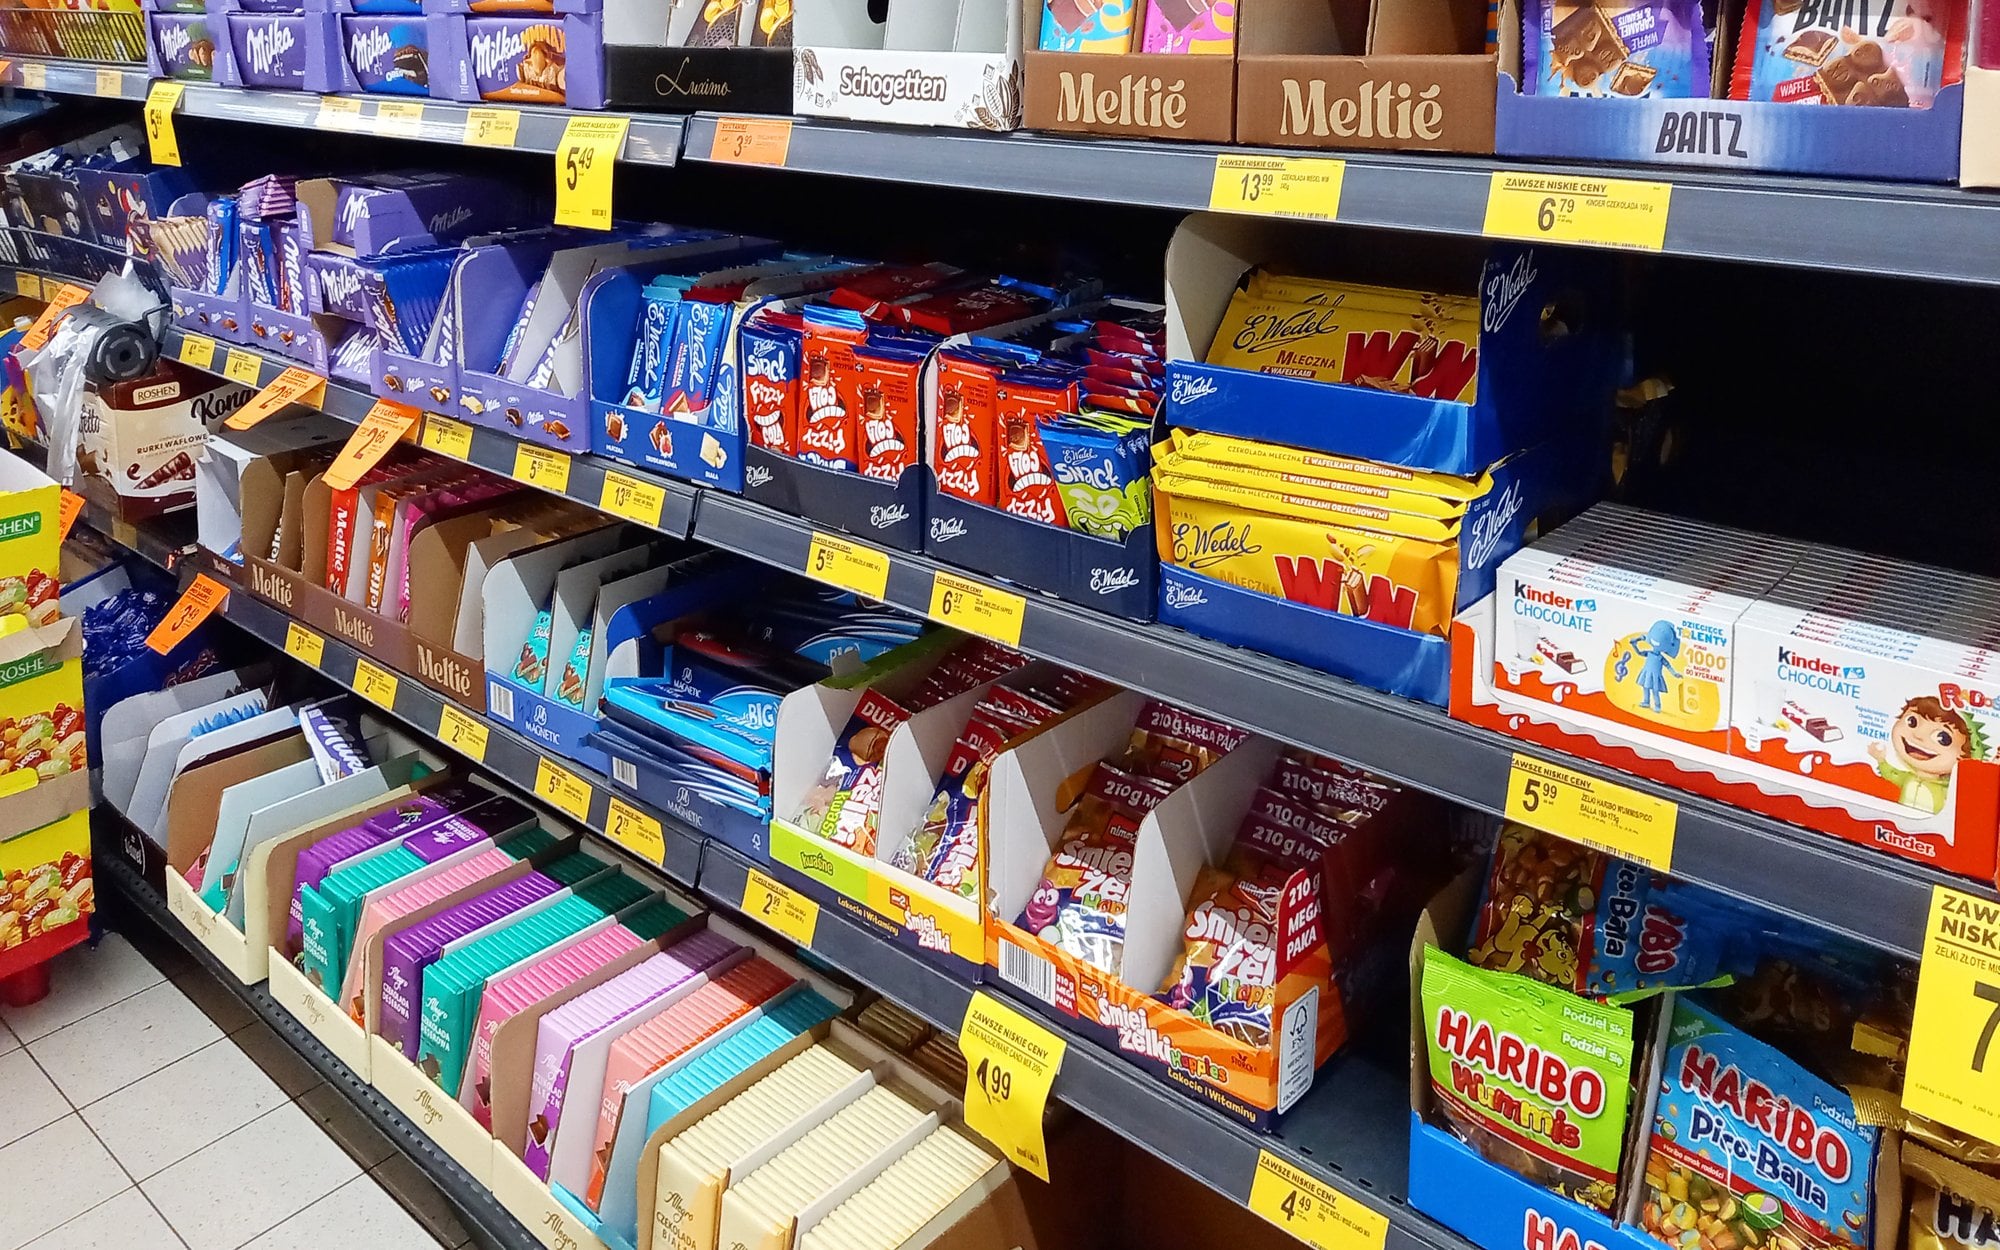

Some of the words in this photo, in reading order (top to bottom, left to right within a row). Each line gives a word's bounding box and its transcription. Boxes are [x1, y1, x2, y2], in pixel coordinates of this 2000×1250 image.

[160, 22, 191, 62] Milka
[1618, 15, 1655, 38] CARAMEL
[1631, 32, 1658, 50] WAFFLE
[246, 19, 294, 74] Milka
[351, 25, 392, 73] Milka
[471, 25, 525, 79] Milka
[655, 56, 732, 97] Luximo
[839, 65, 948, 107] Schogetten
[1780, 79, 1811, 97] WAFFLE
[1057, 71, 1188, 130] Meltié
[1280, 79, 1444, 141] Meltié
[1655, 112, 1748, 159] BAITZ
[566, 147, 579, 191] 5
[579, 148, 595, 170] 49
[1220, 159, 1245, 167] ZAWSZE
[1241, 173, 1261, 201] 13
[1262, 174, 1274, 186] 99
[1505, 178, 1545, 190] ZAWSZE
[1546, 181, 1578, 192] NISKIE
[1580, 183, 1608, 193] CENY
[1537, 198, 1556, 231] 6
[1560, 198, 1575, 213] 79
[320, 266, 361, 306] Milka
[747, 351, 787, 382] Snack
[137, 385, 177, 401] ROSHEN
[750, 380, 785, 405] Fizzy
[808, 386, 836, 411] COLA
[136, 441, 164, 454] RURKI
[163, 432, 209, 450] WAFLOWE
[802, 428, 846, 455] Fizzy
[865, 420, 895, 444] COLA
[943, 424, 970, 449] COLA
[1008, 451, 1040, 479] COLA
[1227, 445, 1267, 458] CZEKOLADA
[1268, 452, 1302, 463] MLECZNA
[1311, 457, 1354, 472] WAFELKAMI
[1355, 464, 1412, 481] ORZECHOWYMI
[1289, 475, 1331, 490] WAFELKAMI
[1331, 481, 1389, 499] ORZECHOWYMI
[1248, 490, 1281, 502] MLECZNA
[1290, 496, 1331, 511] WAFELKAMI
[1331, 502, 1389, 521] ORZECHOWYMI
[334, 506, 348, 572] Meltié
[816, 548, 826, 571] 5
[252, 563, 293, 609] Meltié
[942, 590, 953, 615] 6
[1514, 598, 1593, 634] CHOCOLATE
[334, 606, 375, 649] Meltié
[417, 643, 472, 698] Meltié
[1685, 648, 1727, 671] 1000
[1777, 664, 1862, 700] CHOCOLATE
[747, 702, 775, 730] BIG
[1151, 711, 1172, 730] 210
[525, 721, 560, 746] MAGNETIC
[1857, 726, 1890, 742] RAZEM!
[1104, 780, 1130, 798] 210
[1282, 770, 1310, 791] 210
[1543, 766, 1569, 782] NISKIE
[1570, 776, 1592, 789] CENY
[1522, 778, 1541, 812] 5
[1543, 782, 1558, 799] 99
[667, 799, 703, 828] MAGNETIC
[1252, 825, 1280, 847] 210
[800, 850, 834, 877] kwaśne
[762, 893, 773, 916] 2
[1288, 881, 1311, 908] 210
[866, 911, 900, 937] Witaminy
[1287, 904, 1321, 937] MEGA
[1286, 927, 1318, 961] PAKA
[1960, 953, 1987, 971] ZŁOTE
[382, 982, 410, 1009] CZEKOLADA
[382, 992, 410, 1020] DESEROWA
[1098, 987, 1148, 1033] Śmiej
[421, 1014, 451, 1043] CZEKOLADA
[1563, 1005, 1607, 1031] Podziel
[1971, 979, 2000, 1074] 7
[421, 1025, 451, 1053] DESEROWA
[972, 1009, 1003, 1035] ZAWSZE
[1003, 1024, 1028, 1048] NISKIE
[1027, 1041, 1049, 1060] CENY
[1117, 1021, 1172, 1067] żelki
[1562, 1030, 1607, 1058] Podziel
[1609, 1047, 1625, 1067] się
[1169, 1048, 1228, 1084] Happies
[1436, 1005, 1606, 1119] HARIBO
[991, 1065, 1012, 1101] 99
[413, 1087, 443, 1126] Allegro
[1208, 1086, 1257, 1123] Witaminy
[1451, 1058, 1582, 1150] Wummis
[1678, 1043, 1853, 1184] HARIBO
[1812, 1093, 1858, 1131] Podziel
[1857, 1125, 1873, 1144] się
[1689, 1104, 1827, 1211] Pico-Balla
[1701, 1161, 1726, 1182] radości
[1261, 1155, 1291, 1179] ZAWSZE
[1291, 1171, 1315, 1193] NISKIE
[1316, 1186, 1337, 1205] CENY
[663, 1190, 695, 1223] Allegro
[1280, 1189, 1298, 1222] 4
[1298, 1195, 1312, 1213] 49
[656, 1211, 697, 1250] CZEKOLADA
